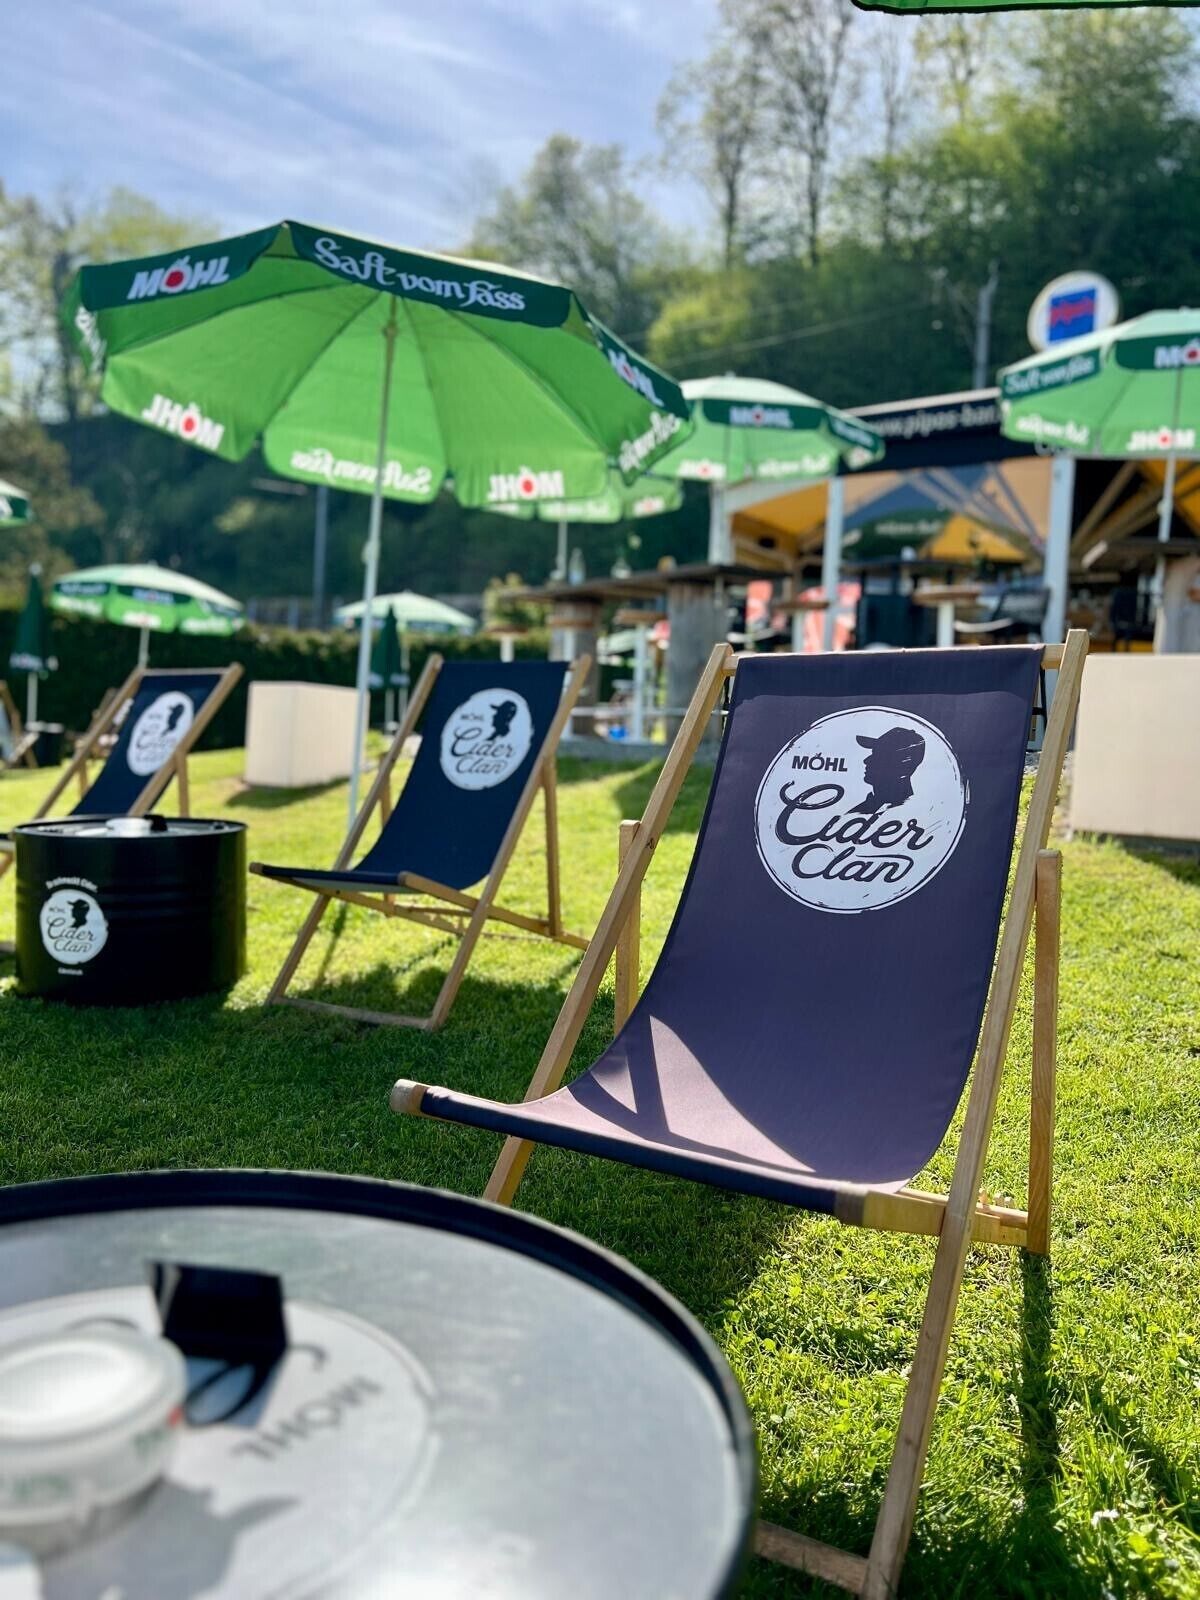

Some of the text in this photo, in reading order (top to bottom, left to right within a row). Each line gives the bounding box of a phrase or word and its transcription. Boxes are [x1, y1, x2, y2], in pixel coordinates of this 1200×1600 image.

[314, 237, 396, 286] Saft
[397, 272, 465, 299] vom
[451, 726, 517, 758] Cider
[456, 756, 508, 774] Clan
[775, 780, 934, 851] Cider
[791, 843, 914, 883] Clan
[47, 916, 97, 942] Cider
[54, 938, 93, 953] Clan
